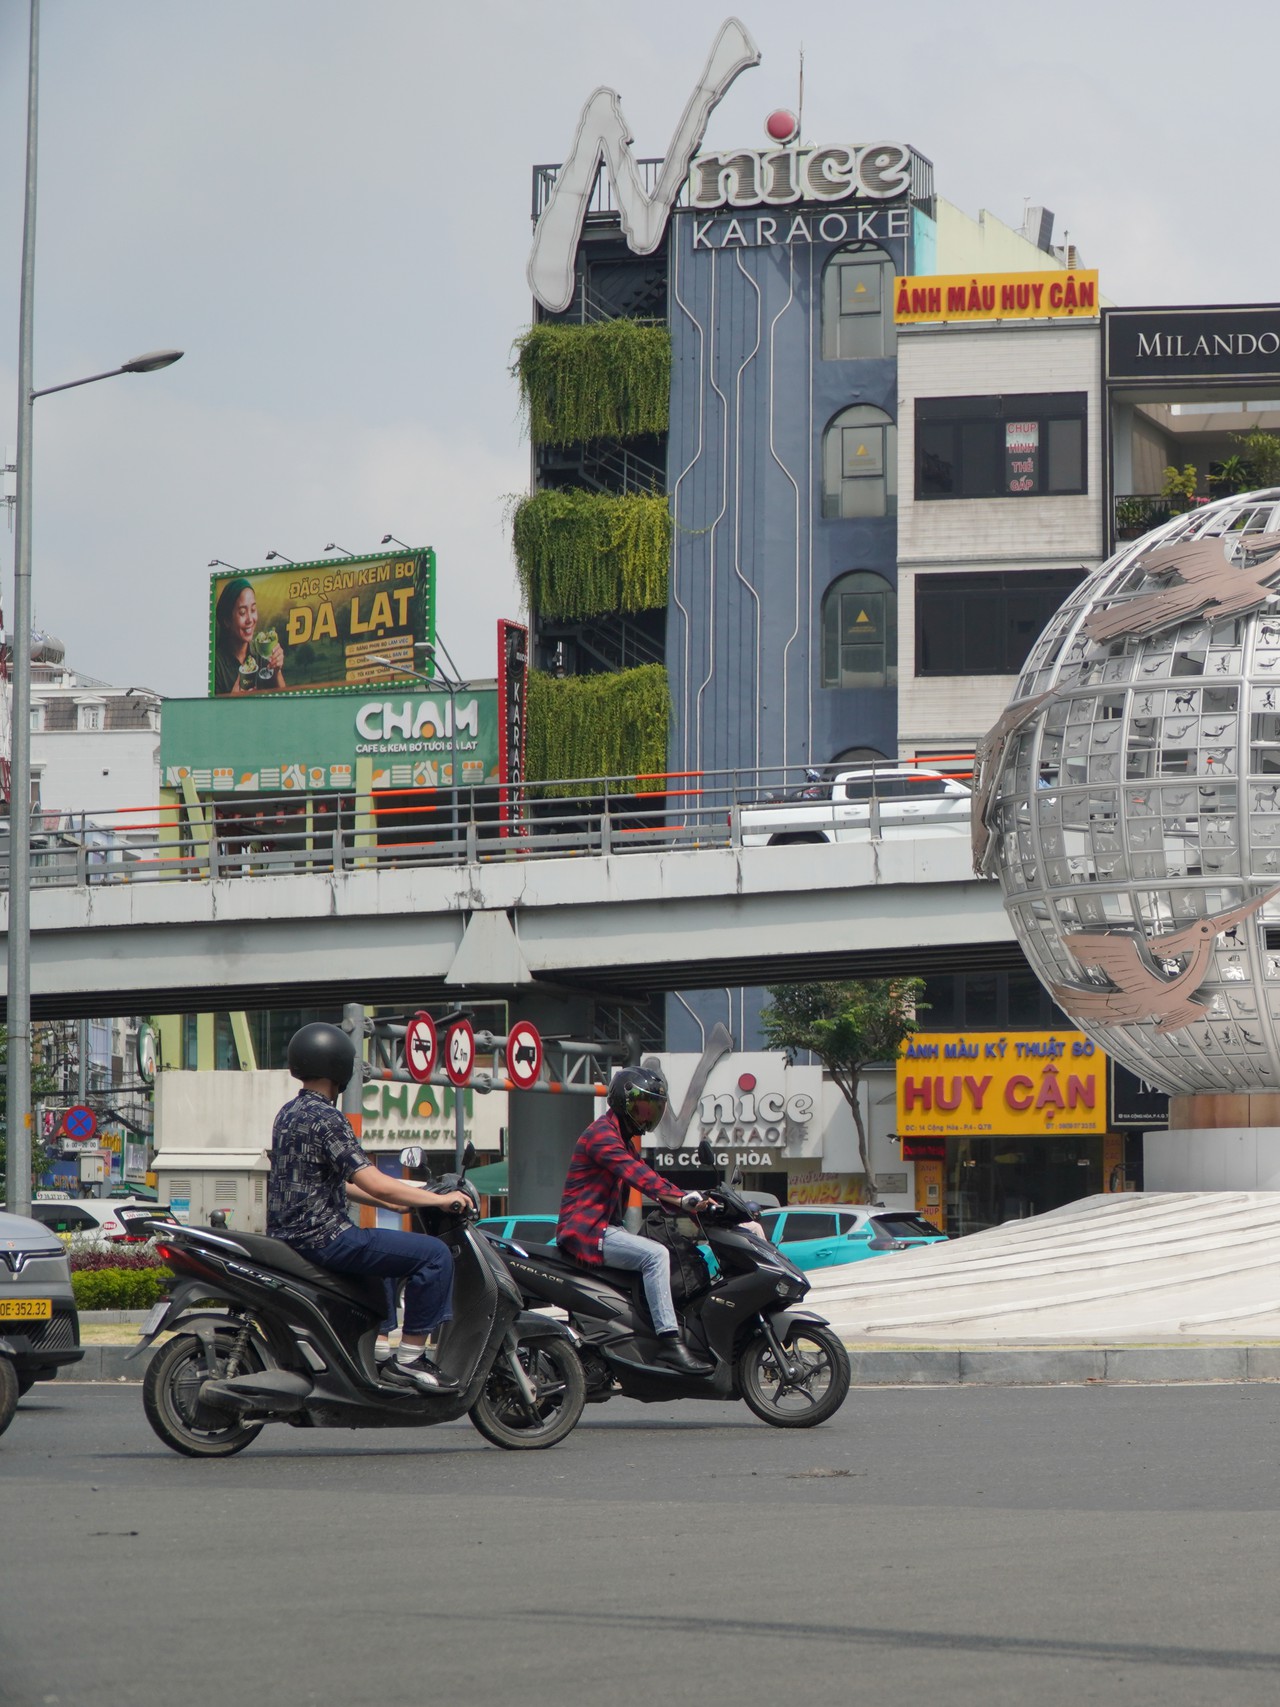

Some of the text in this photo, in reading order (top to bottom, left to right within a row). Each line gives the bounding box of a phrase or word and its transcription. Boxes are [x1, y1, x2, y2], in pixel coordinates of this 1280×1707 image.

[690, 108, 911, 208] nice
[693, 209, 909, 249] KARAOKE
[896, 275, 1095, 315] ẢNH MÀU HUY CẬN
[289, 578, 320, 599] ĐẶC
[323, 570, 355, 592] SẢN
[358, 564, 392, 586] KEM
[286, 587, 415, 646] ĐÀ LẠT
[356, 743, 378, 753] CAFE
[388, 742, 407, 753] KEM
[1015, 1036, 1066, 1061] THUẬT
[700, 1073, 814, 1124] nice
[904, 1063, 1096, 1118] HUY CẬN
[362, 1129, 384, 1140] AFE
[397, 1129, 422, 1140] KEM
[701, 1126, 809, 1144] KARAOKE
[656, 1153, 674, 1166] 16
[735, 1150, 773, 1166] HÒA
[509, 1260, 565, 1284] AIRBLADE
